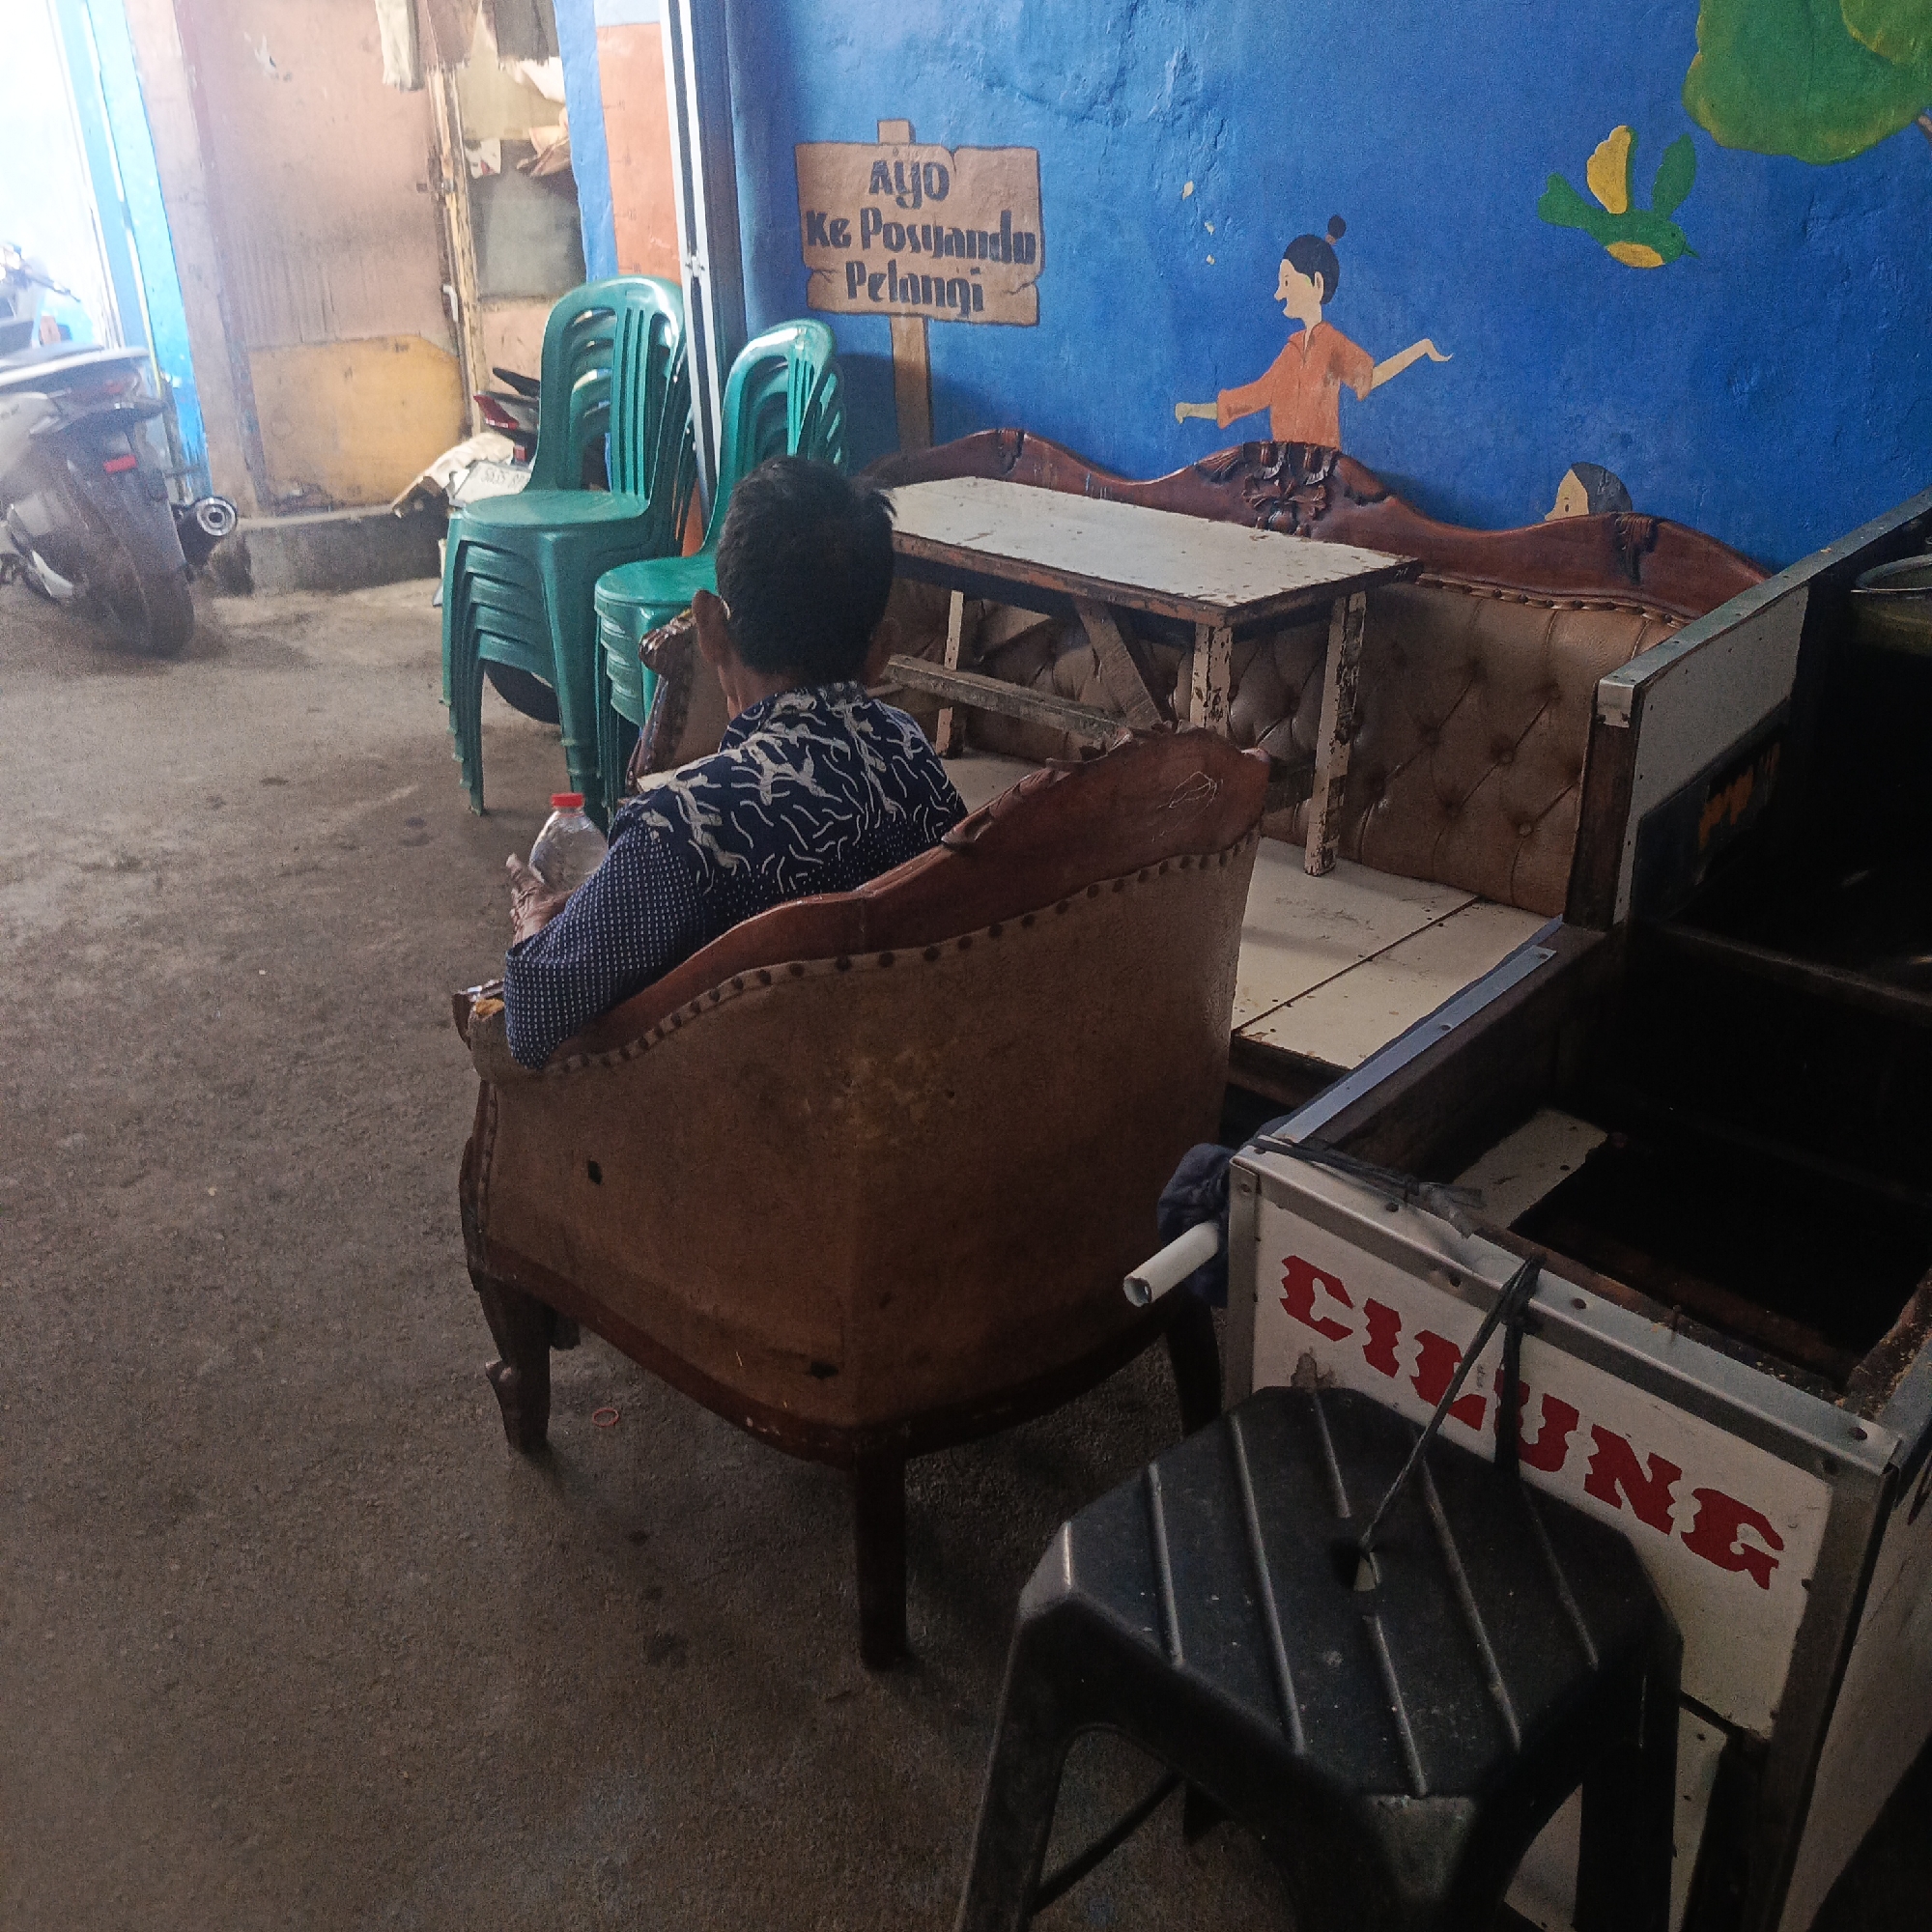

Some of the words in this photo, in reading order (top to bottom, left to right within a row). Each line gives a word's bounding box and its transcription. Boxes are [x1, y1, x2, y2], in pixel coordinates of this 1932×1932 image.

[860, 207, 1037, 266] Posyandu
[845, 259, 984, 319] Pelangi
[1279, 1255, 1785, 1590] CILUNG
